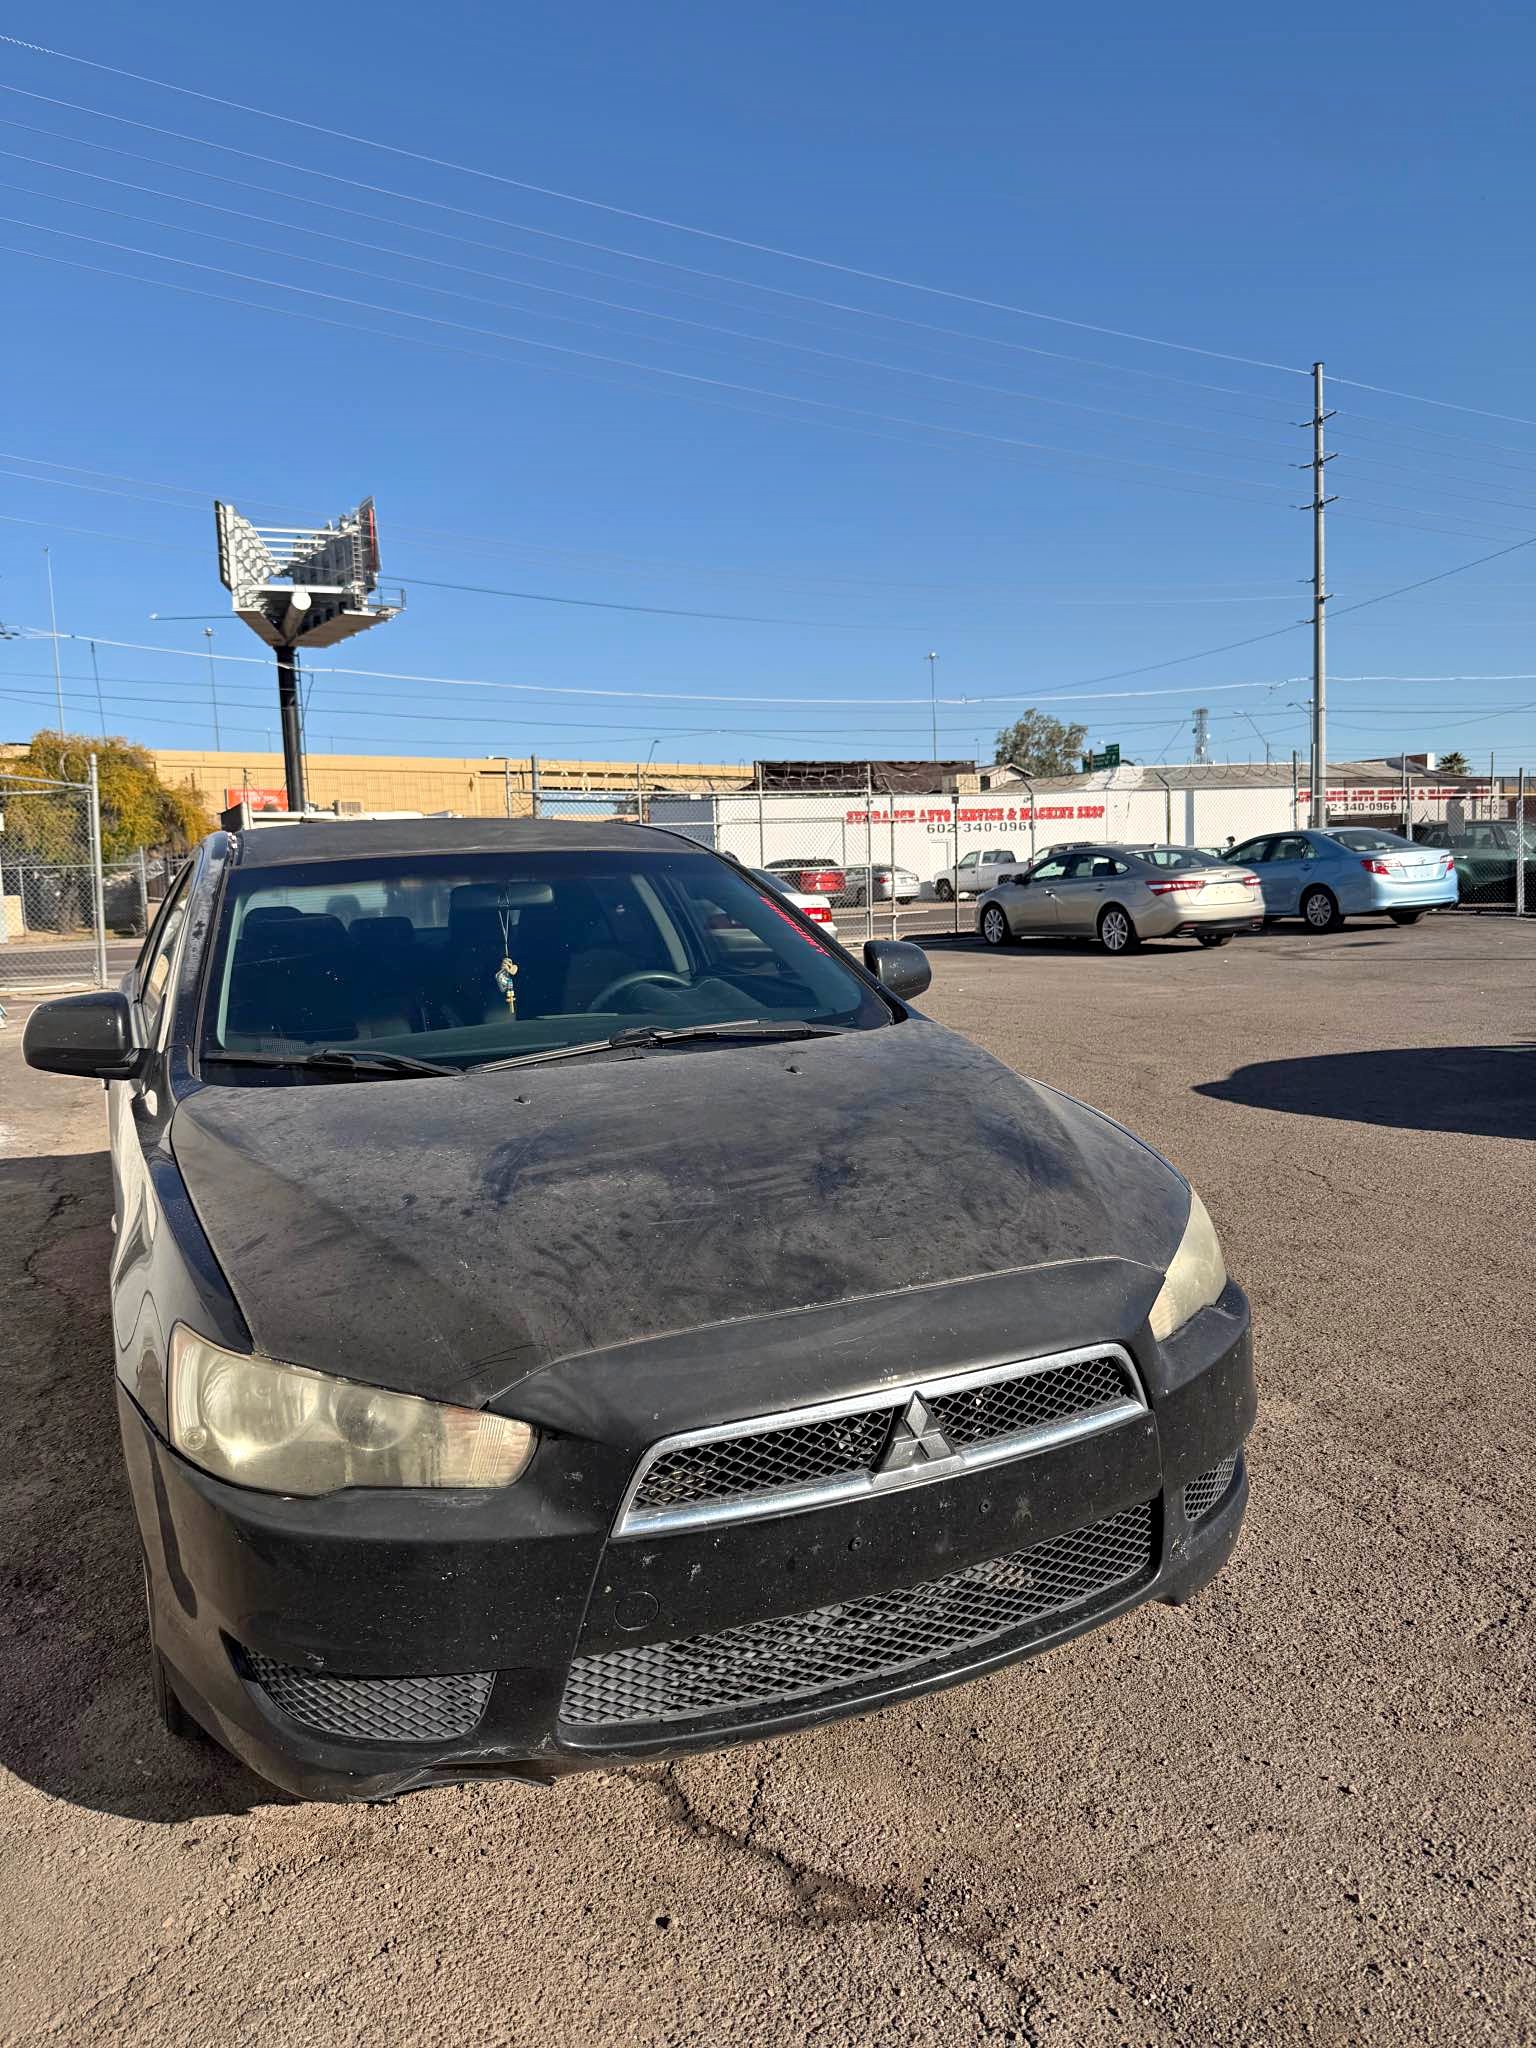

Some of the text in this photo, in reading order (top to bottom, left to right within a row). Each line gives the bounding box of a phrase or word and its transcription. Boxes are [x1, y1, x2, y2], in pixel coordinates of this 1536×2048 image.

[919, 809, 951, 823] AUTO
[1007, 807, 1017, 820] &
[1020, 806, 1074, 820] MACHINE
[1077, 805, 1105, 818] SHOP
